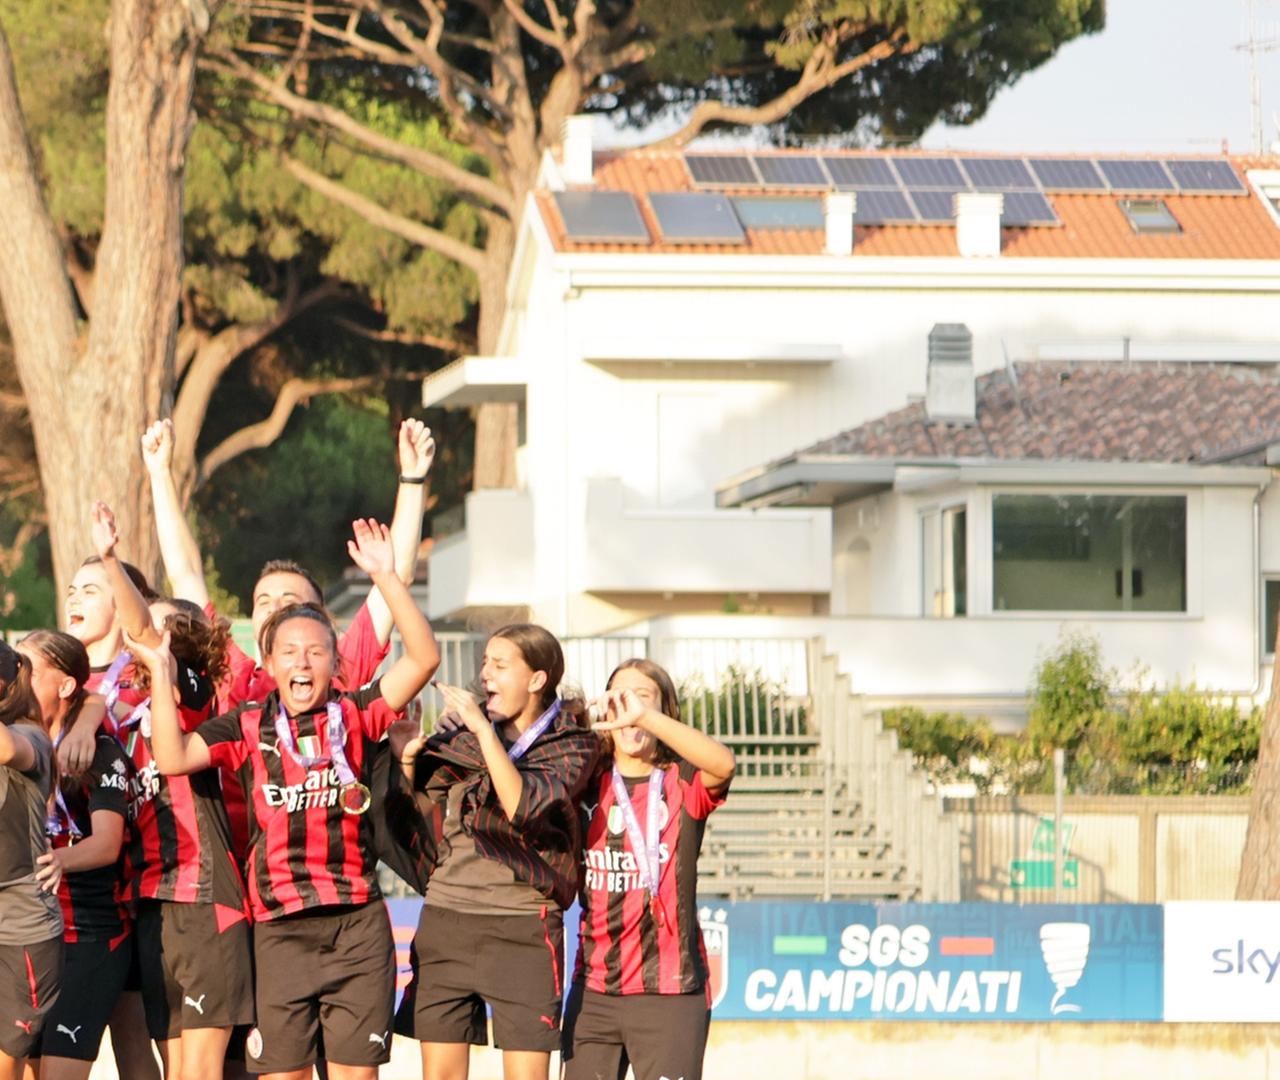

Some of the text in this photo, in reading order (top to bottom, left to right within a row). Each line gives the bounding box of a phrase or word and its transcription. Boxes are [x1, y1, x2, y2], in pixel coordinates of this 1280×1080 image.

[100, 773, 127, 792] MS
[286, 788, 338, 814] BETTER
[607, 871, 648, 893] BETT
[840, 924, 931, 968] SGS
[1212, 939, 1280, 984] sky
[744, 968, 1023, 1014] CAMPIONATI
